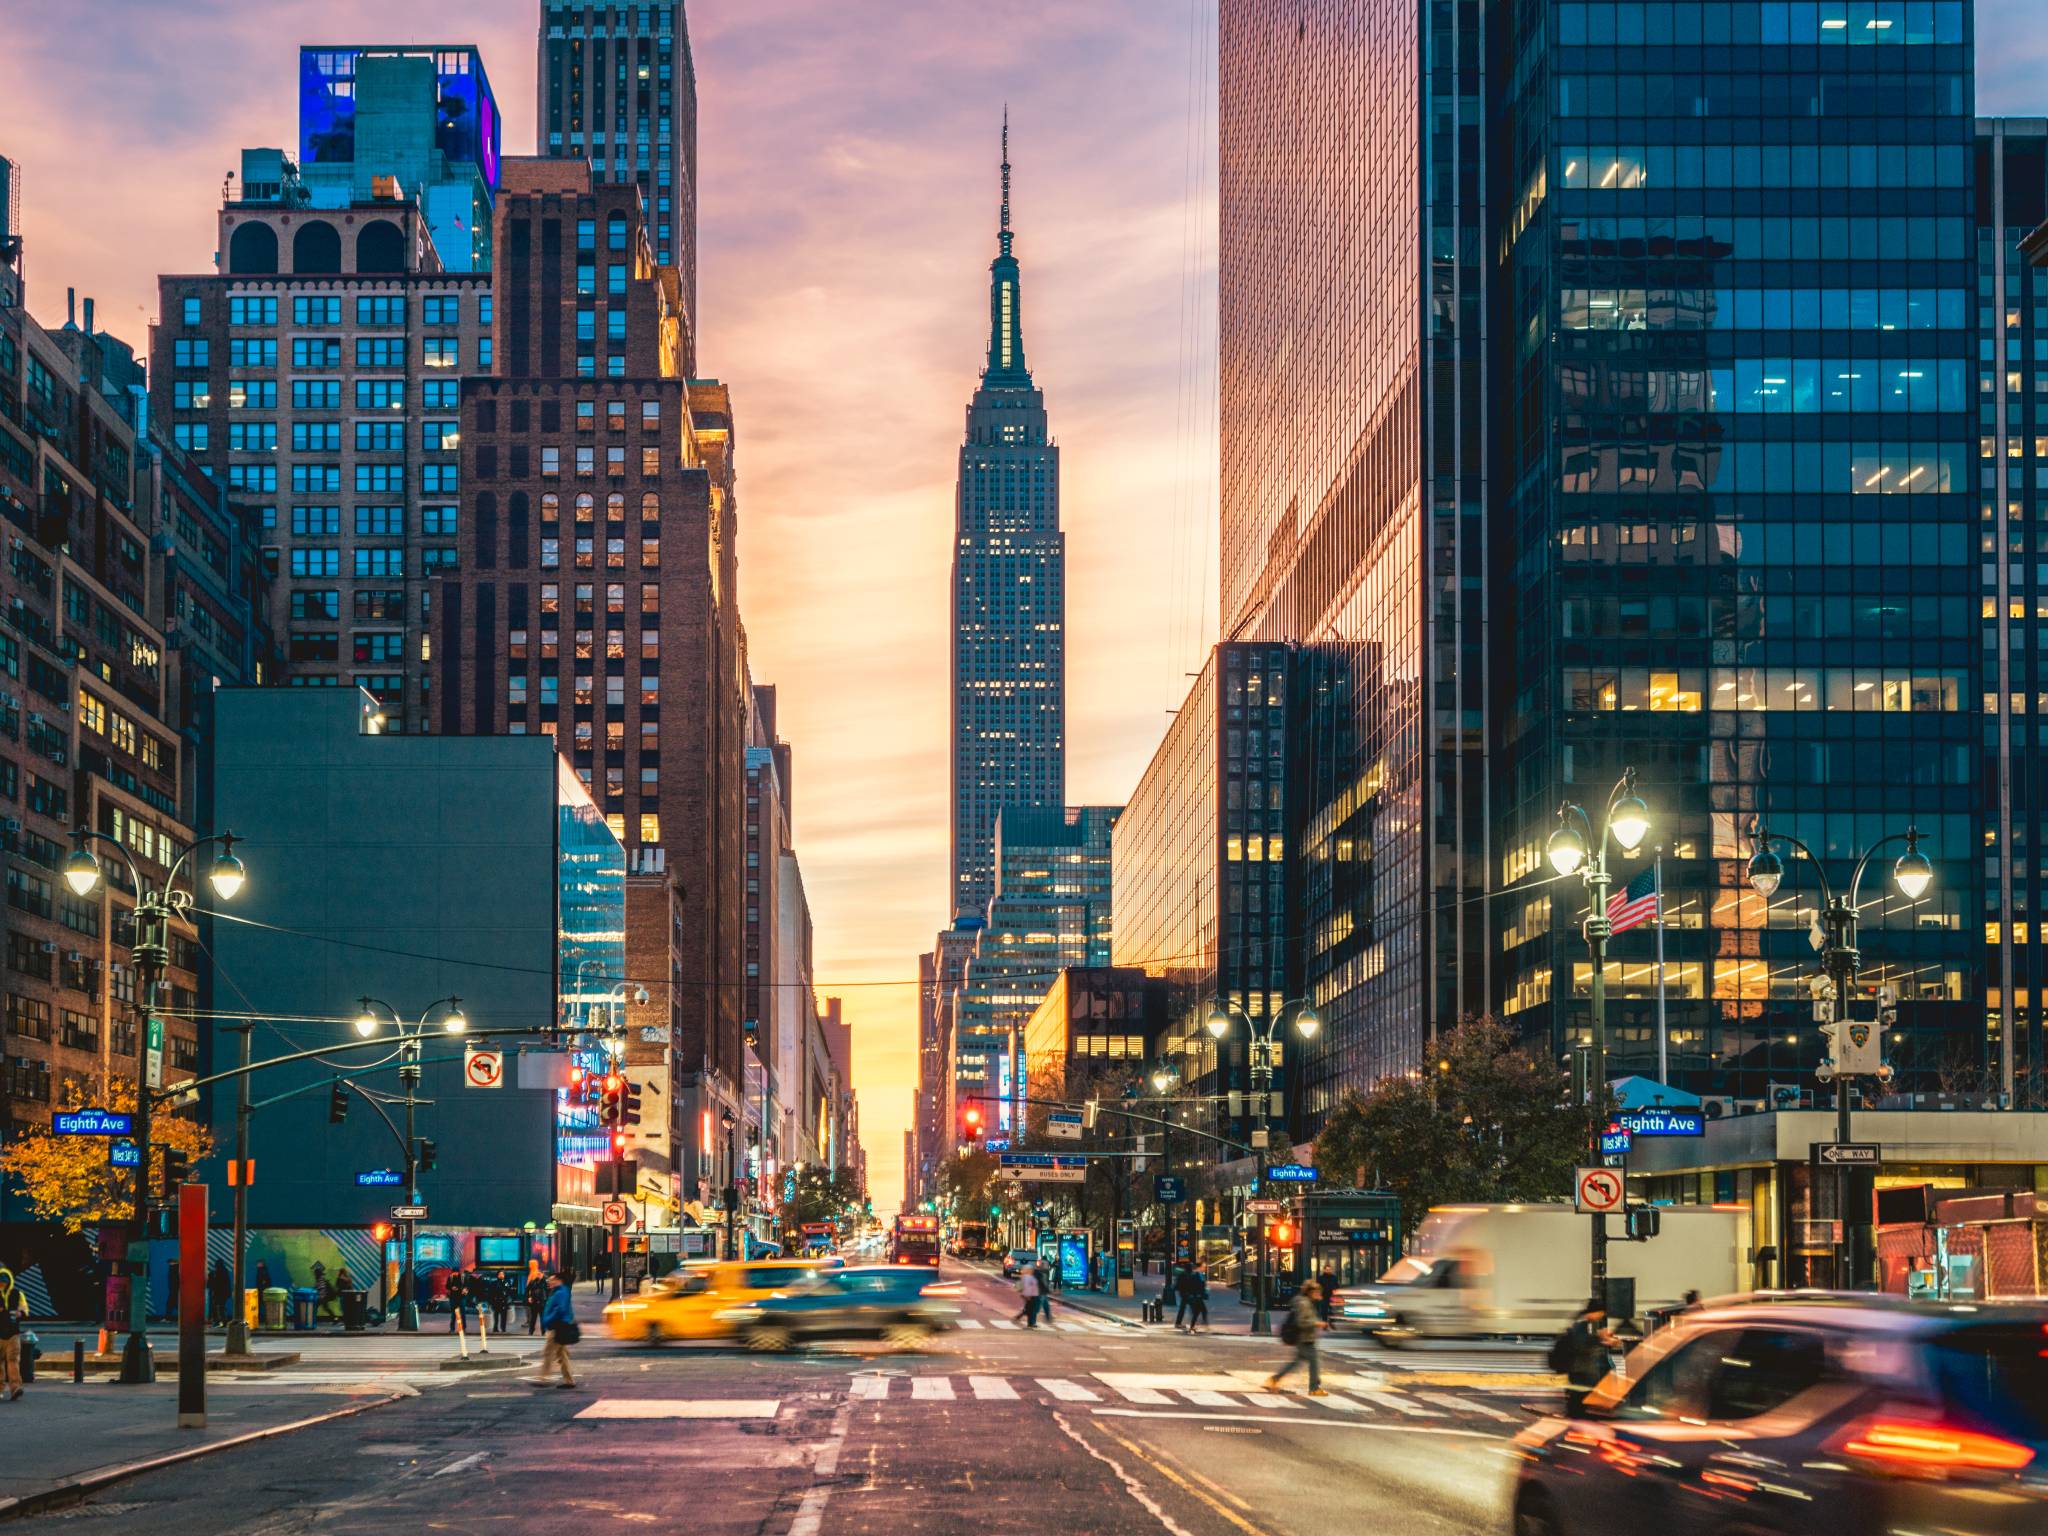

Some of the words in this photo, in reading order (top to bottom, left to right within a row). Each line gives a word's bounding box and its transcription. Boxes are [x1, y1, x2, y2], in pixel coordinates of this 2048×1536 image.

[59, 1117, 98, 1132] Eighth
[101, 1118, 124, 1129] Ave
[1620, 1116, 1664, 1133] Eighth
[1668, 1117, 1695, 1130] Ave
[1829, 1150, 1844, 1159] ONE
[1852, 1150, 1869, 1158] WAY
[1272, 1169, 1297, 1179] Eighth
[1298, 1170, 1313, 1178] Ave
[360, 1175, 383, 1184] Eighth
